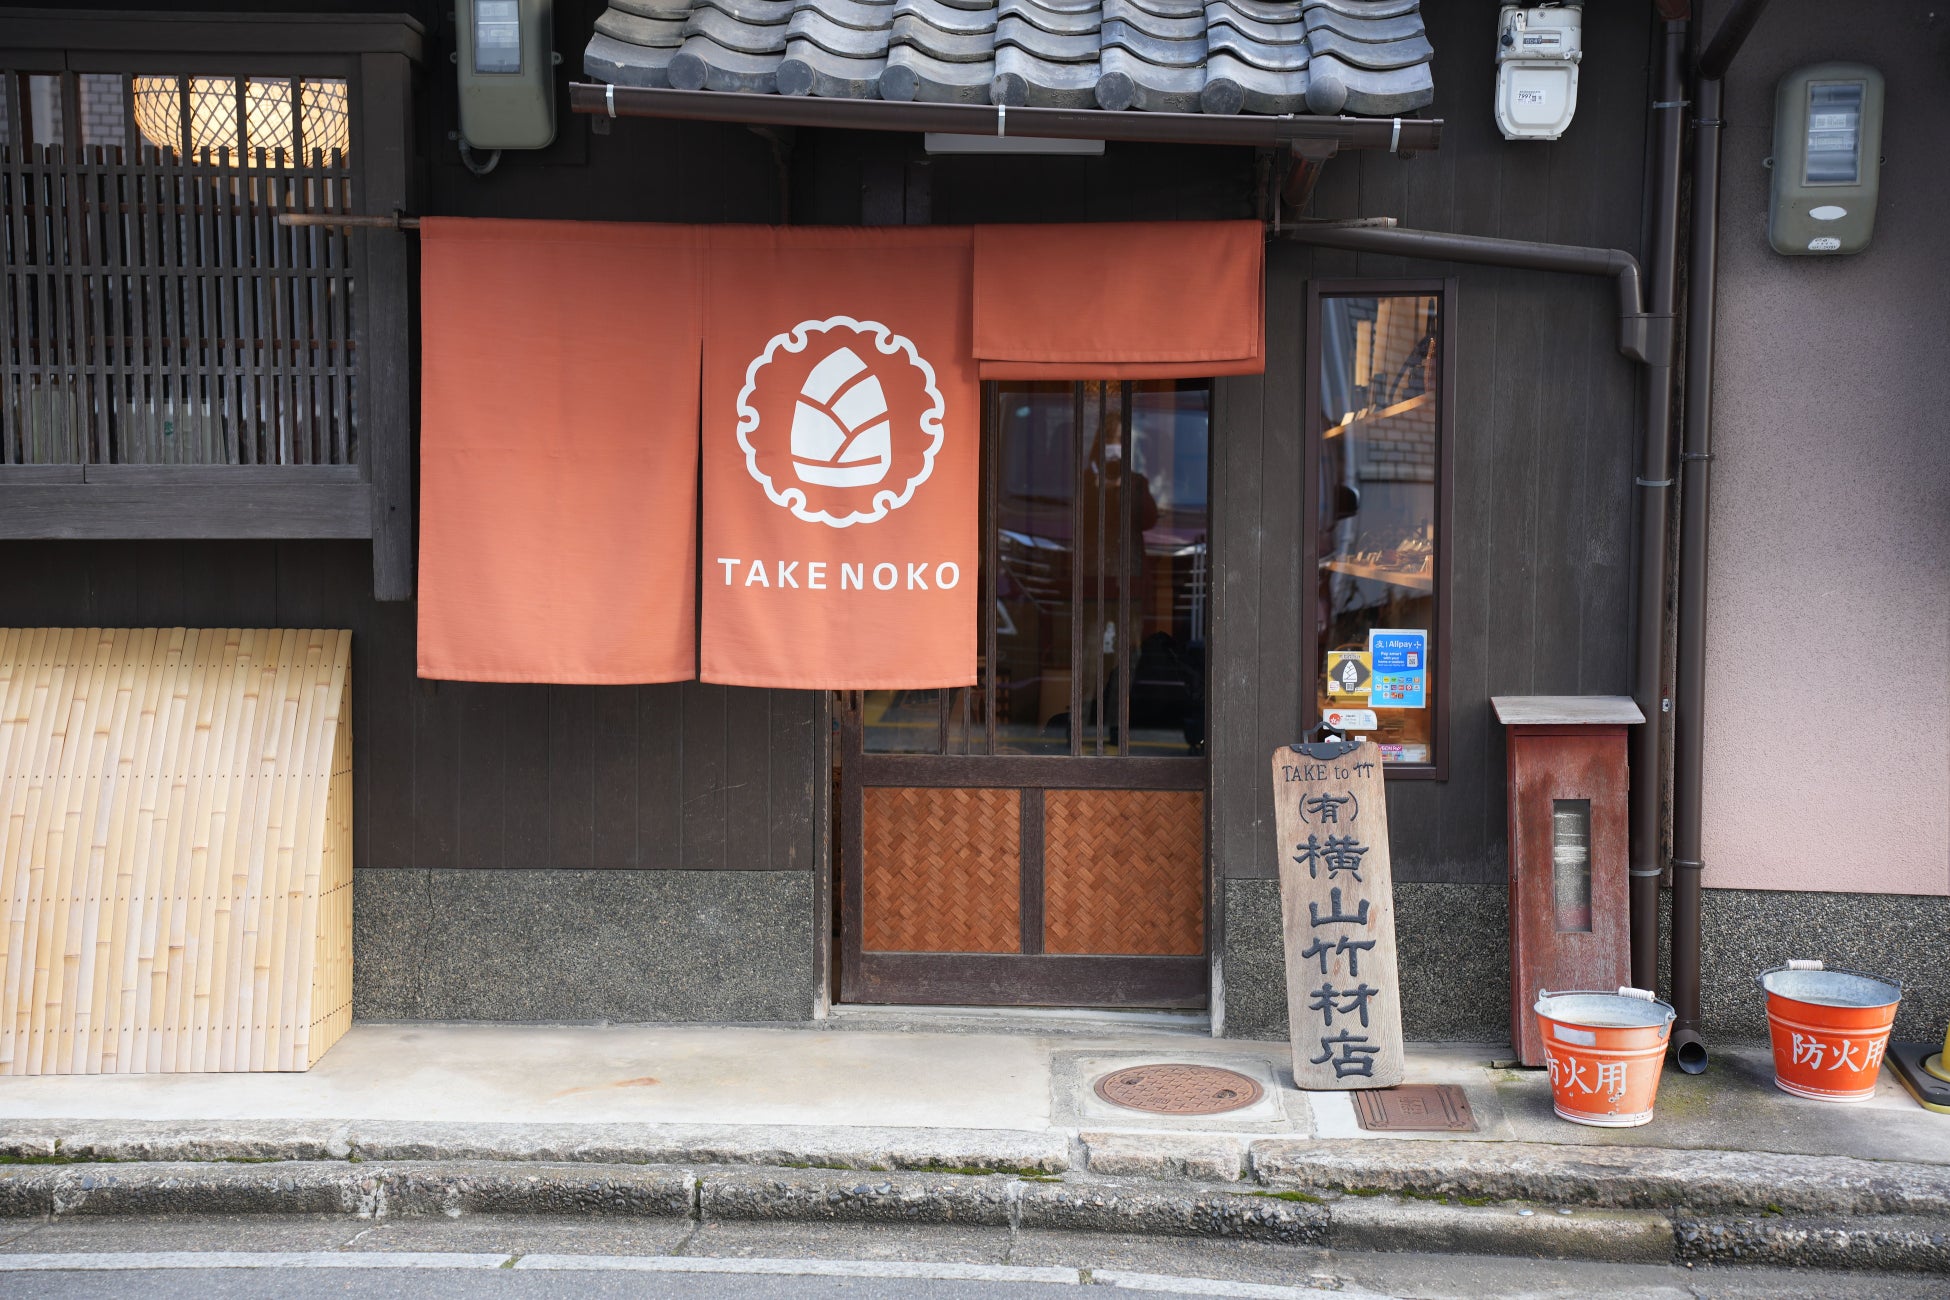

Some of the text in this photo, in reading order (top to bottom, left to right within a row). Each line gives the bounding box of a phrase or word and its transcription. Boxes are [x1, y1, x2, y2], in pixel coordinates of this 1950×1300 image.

[717, 557, 960, 591] TAKENOKO
[1282, 764, 1328, 782] TAKE
[1334, 766, 1349, 780] to
[1791, 1032, 1886, 1073] 防火用
